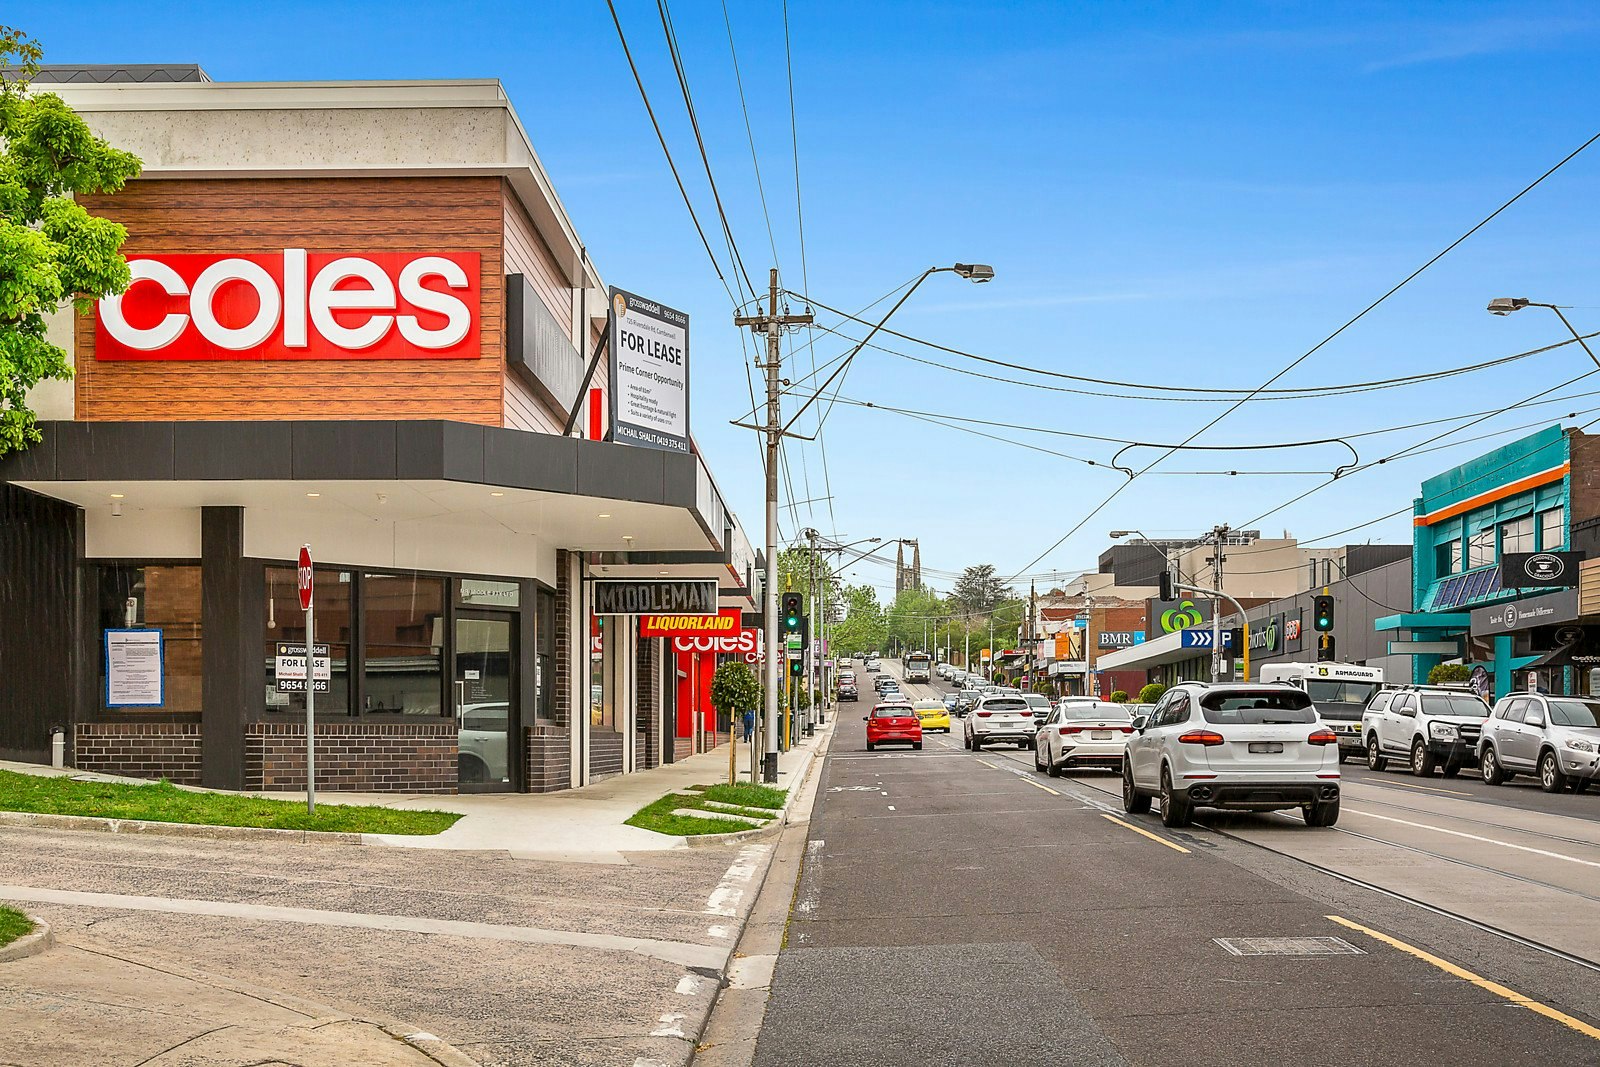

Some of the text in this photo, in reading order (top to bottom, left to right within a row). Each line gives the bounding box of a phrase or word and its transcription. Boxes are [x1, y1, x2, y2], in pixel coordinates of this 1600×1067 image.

[98, 248, 471, 350] coles
[663, 310, 675, 321] 9654
[675, 312, 686, 325] 8666
[621, 329, 682, 366] FOR LEASE
[619, 361, 684, 391] Prime Corner Opportunity
[617, 425, 687, 451] MICHAIL SHALIT 0419 375 411
[298, 566, 312, 590] STOP
[599, 582, 714, 613] MIDDLEMAN
[647, 616, 735, 631] LIQUORLAND
[674, 631, 754, 651] coles
[1100, 633, 1131, 644] BMR
[1222, 632, 1232, 645] P
[287, 646, 327, 655] grosswddell
[281, 659, 325, 668] FOR LSE
[1334, 670, 1374, 678] ARMAGUARD
[280, 680, 303, 690] 9654
